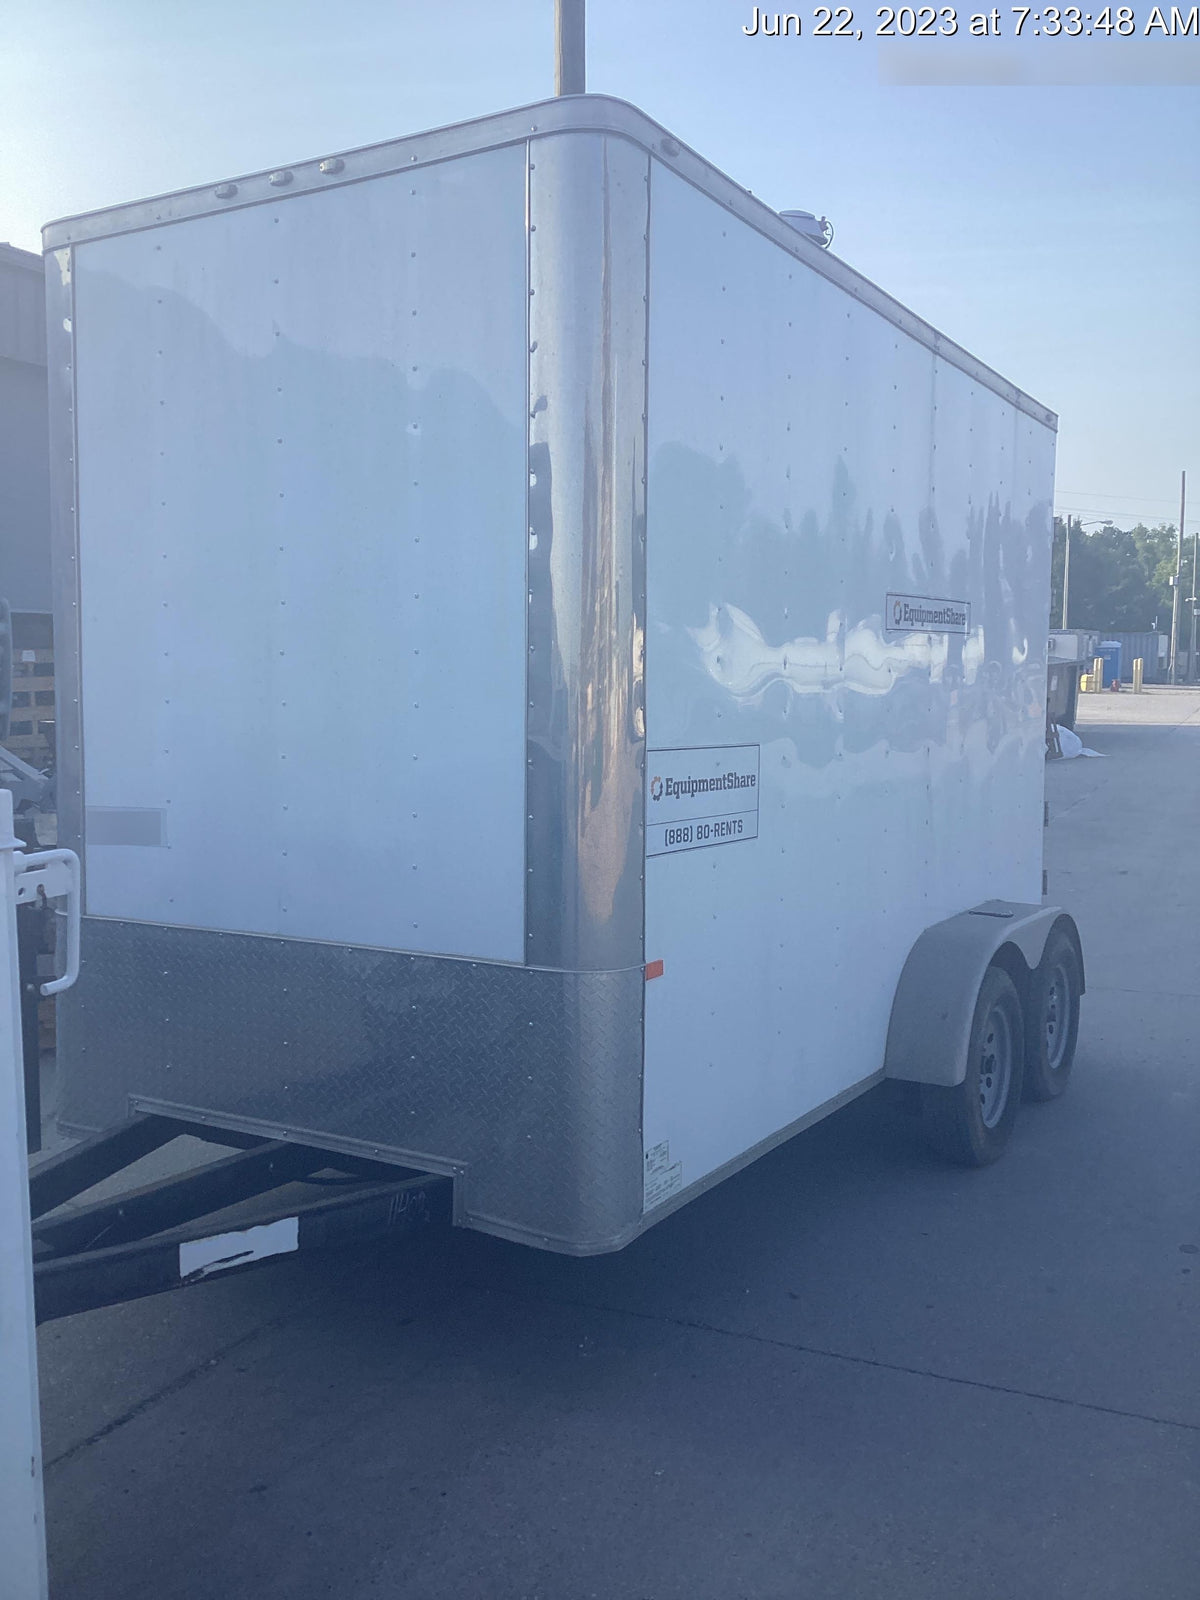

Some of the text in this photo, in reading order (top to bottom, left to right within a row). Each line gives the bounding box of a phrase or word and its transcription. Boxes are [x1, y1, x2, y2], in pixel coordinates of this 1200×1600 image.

[903, 603, 966, 627] EquipmentShare
[665, 772, 756, 799] EquipmentShare
[664, 819, 743, 846] (888) 80-RENTS
